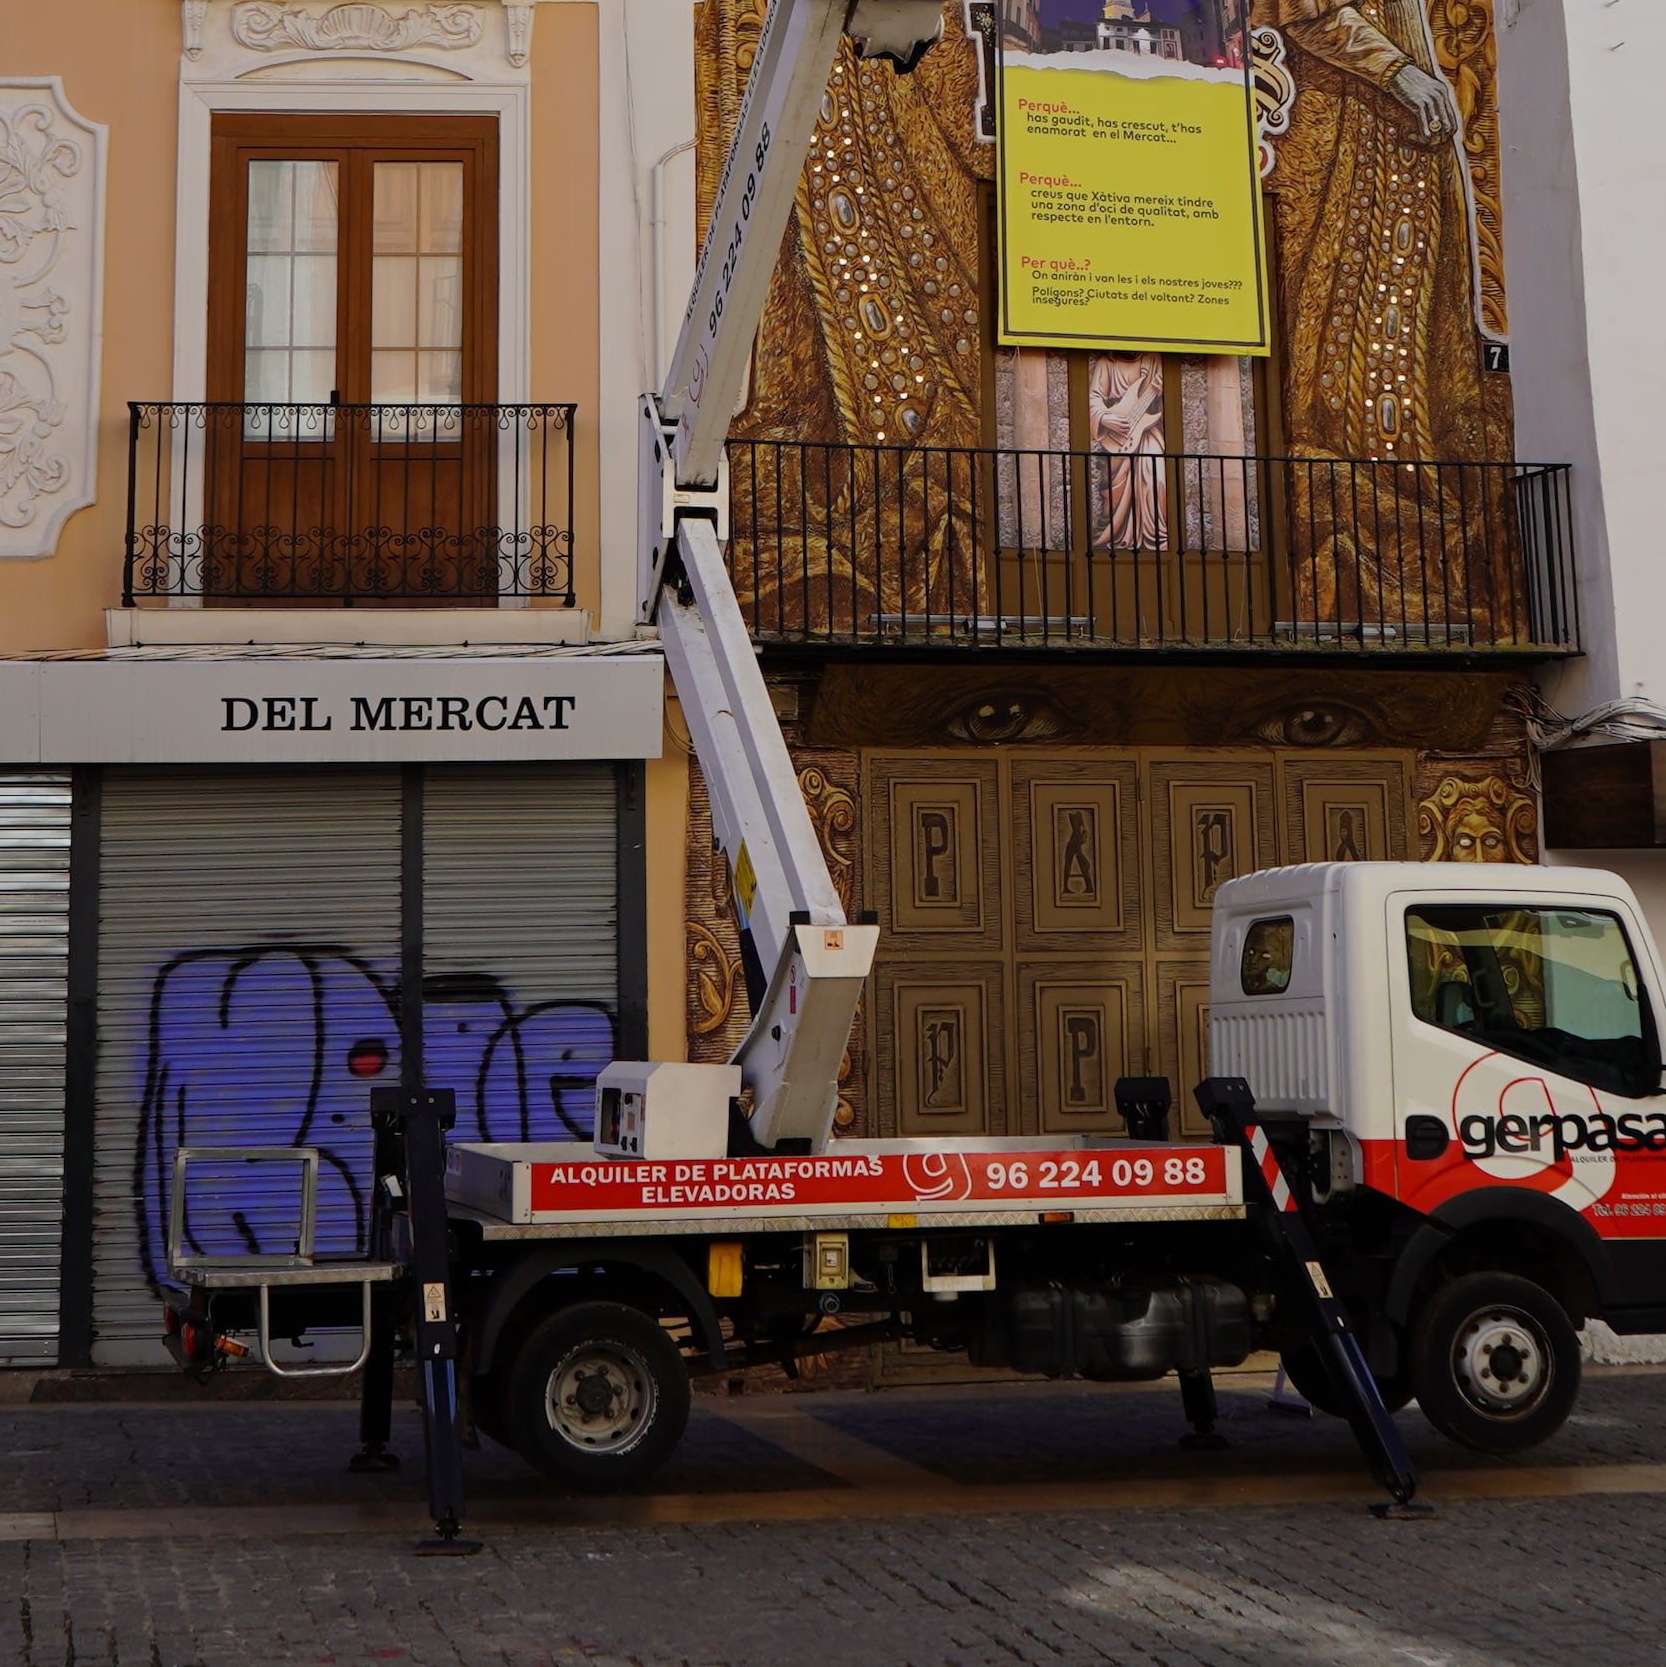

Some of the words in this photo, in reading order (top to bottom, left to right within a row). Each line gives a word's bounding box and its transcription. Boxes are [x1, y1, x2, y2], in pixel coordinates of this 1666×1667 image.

[1018, 98, 1080, 114] Perquè...
[1027, 112, 1048, 123] has
[1051, 114, 1094, 127] gaudit,
[1097, 117, 1118, 129] has
[1121, 121, 1169, 133] crescut,
[1171, 122, 1202, 134] t'has
[1027, 124, 1086, 137] enamorat
[1092, 129, 1107, 139] en
[1110, 129, 1121, 140] el
[1123, 131, 1177, 144] Mercat...
[1020, 172, 1082, 188] Perquè...
[1031, 189, 1063, 200] creus
[1066, 191, 1088, 203] que
[1091, 191, 1131, 204] Xàtiva
[1134, 193, 1174, 206] mereix
[1178, 195, 1213, 208] tindre
[686, 249, 710, 326] ALQUILER
[714, 100, 749, 222] PLATAFORMAS
[1031, 212, 1084, 224] respecte
[1087, 214, 1102, 224] en
[1105, 214, 1155, 228] l'entorn.
[1032, 200, 1054, 210] una
[1057, 202, 1086, 213] zona
[1089, 202, 1116, 214] d'oci
[1119, 204, 1134, 215] de
[1137, 205, 1190, 220] qualitat,
[1192, 208, 1219, 220] amb
[708, 291, 724, 340] 96
[721, 222, 743, 290] 224
[741, 173, 757, 223] 09
[754, 121, 771, 171] 88
[1021, 256, 1046, 269] Per
[1049, 258, 1091, 272] què..?
[1032, 270, 1048, 280] On
[1095, 274, 1115, 283] van
[1117, 273, 1133, 284] les
[1141, 275, 1156, 286] els
[1159, 277, 1199, 288] nostres
[1201, 279, 1243, 291] joves???
[1032, 296, 1091, 307] insegures?
[1087, 288, 1129, 301] Ciutats
[1132, 290, 1148, 302] del
[1150, 292, 1195, 304] voltant?
[1197, 295, 1229, 305] Zones
[1489, 346, 1502, 370] 7
[220, 697, 332, 731] DEL
[349, 696, 576, 731] MERCAT
[550, 1166, 667, 1186] ALQUILER
[675, 1164, 706, 1181] DE
[713, 1159, 883, 1182] PLATAFORMAS
[986, 1162, 1029, 1190] 96
[1038, 1161, 1103, 1189] 224
[1112, 1159, 1154, 1186] 09
[1163, 1157, 1206, 1185] 88
[641, 1183, 796, 1203] ELEVADORAS
